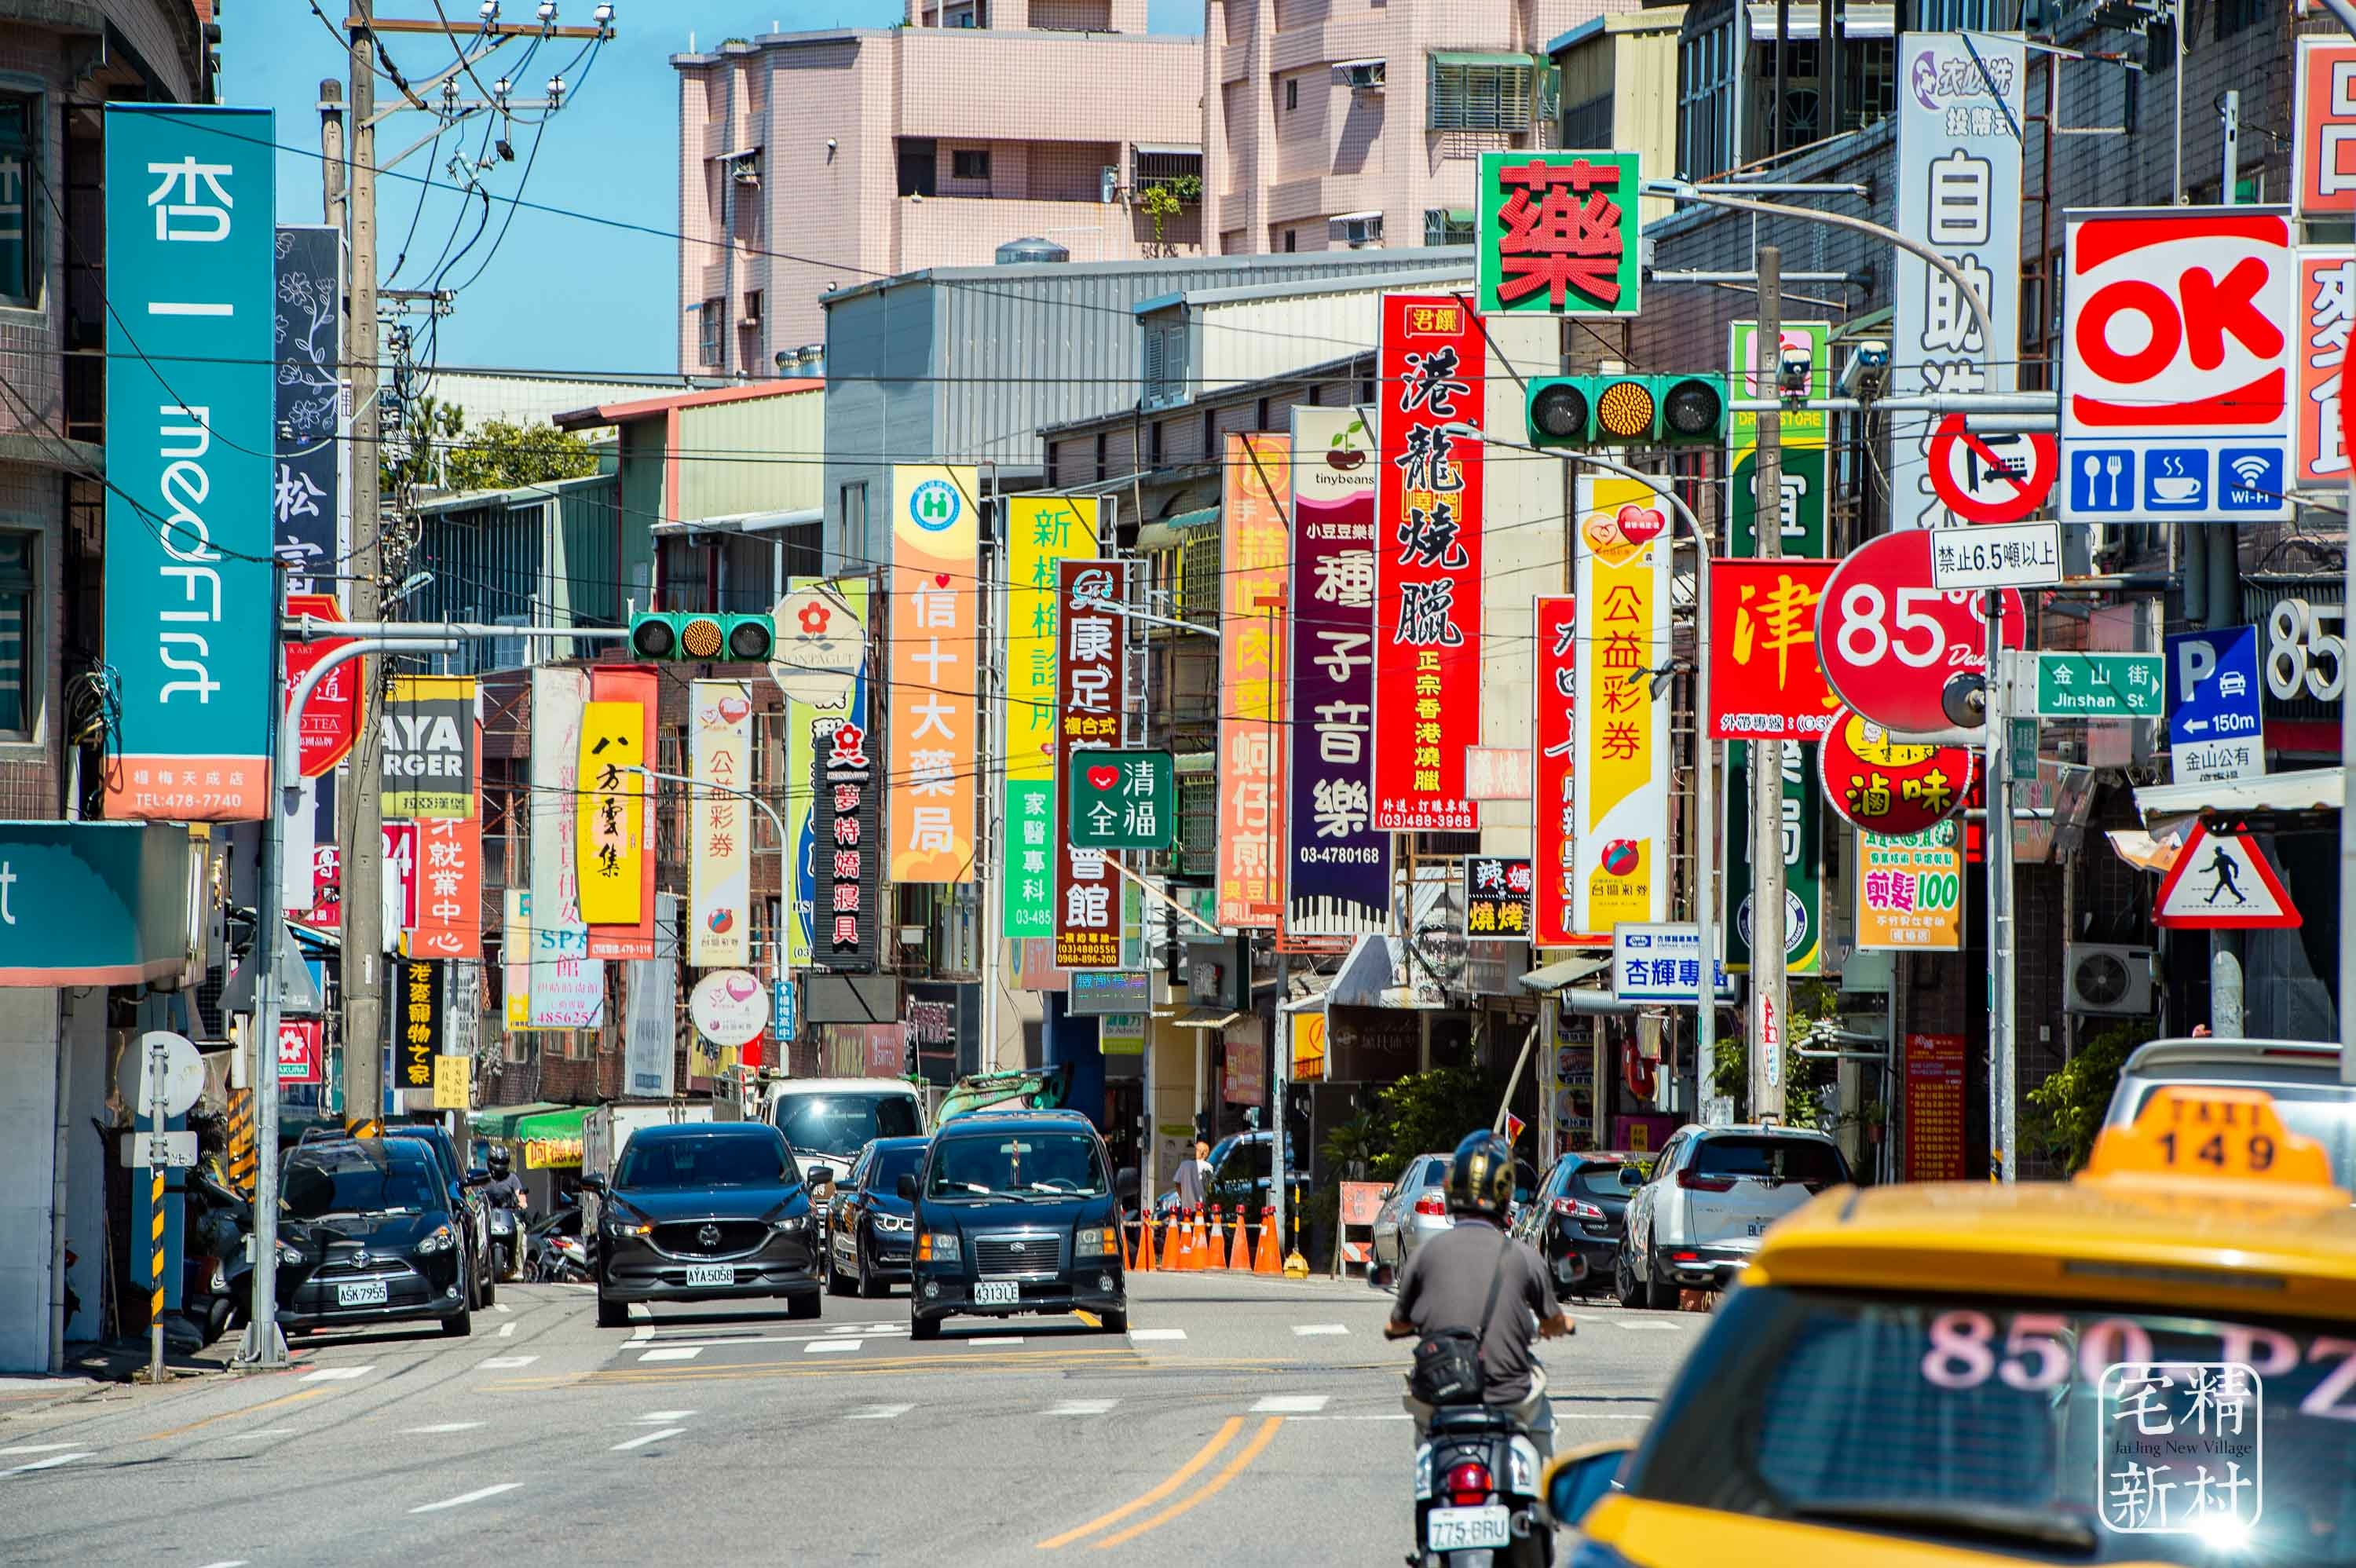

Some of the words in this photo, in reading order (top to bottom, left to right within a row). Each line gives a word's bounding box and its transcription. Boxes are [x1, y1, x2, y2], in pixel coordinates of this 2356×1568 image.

[148, 156, 233, 316] 杏一
[1497, 159, 1623, 305] 藥
[2076, 257, 2285, 385] OK
[1315, 473, 1374, 485] tinybeans
[1395, 345, 1471, 646] 港龍燒臘
[2231, 491, 2270, 504] Wi-Fi
[1068, 616, 1113, 714] 康足
[1602, 585, 1642, 760] 公益彩券
[2052, 663, 2149, 686] 金山街
[2178, 640, 2216, 702] P
[1313, 549, 1374, 838] 種子音樂
[2052, 693, 2116, 707] Jinshan
[2127, 693, 2149, 707] St.
[909, 580, 958, 853] 信十大藥局
[1064, 717, 1117, 735] 複合式
[1413, 651, 1442, 792] 正宗香港燒臘
[2212, 713, 2255, 733] 150m
[2185, 747, 2250, 772] 金山公有
[591, 736, 629, 877] 八方雲集
[710, 750, 734, 858] 公益彩券
[1123, 760, 1156, 836] 清福
[1846, 768, 1952, 817] 滷味
[1087, 801, 1118, 835] 全
[1379, 813, 1472, 828] (03)488-3968
[1023, 791, 1046, 903] 家醫專科
[1301, 846, 1379, 864] 03-4780168
[1223, 880, 1278, 901] 臭豆
[1476, 860, 1531, 891] 辣媽
[1469, 901, 1524, 932] 燒烤
[279, 1065, 306, 1075] AKURA
[2159, 1131, 2275, 1171] 149
[338, 1285, 386, 1303] ASK-7955
